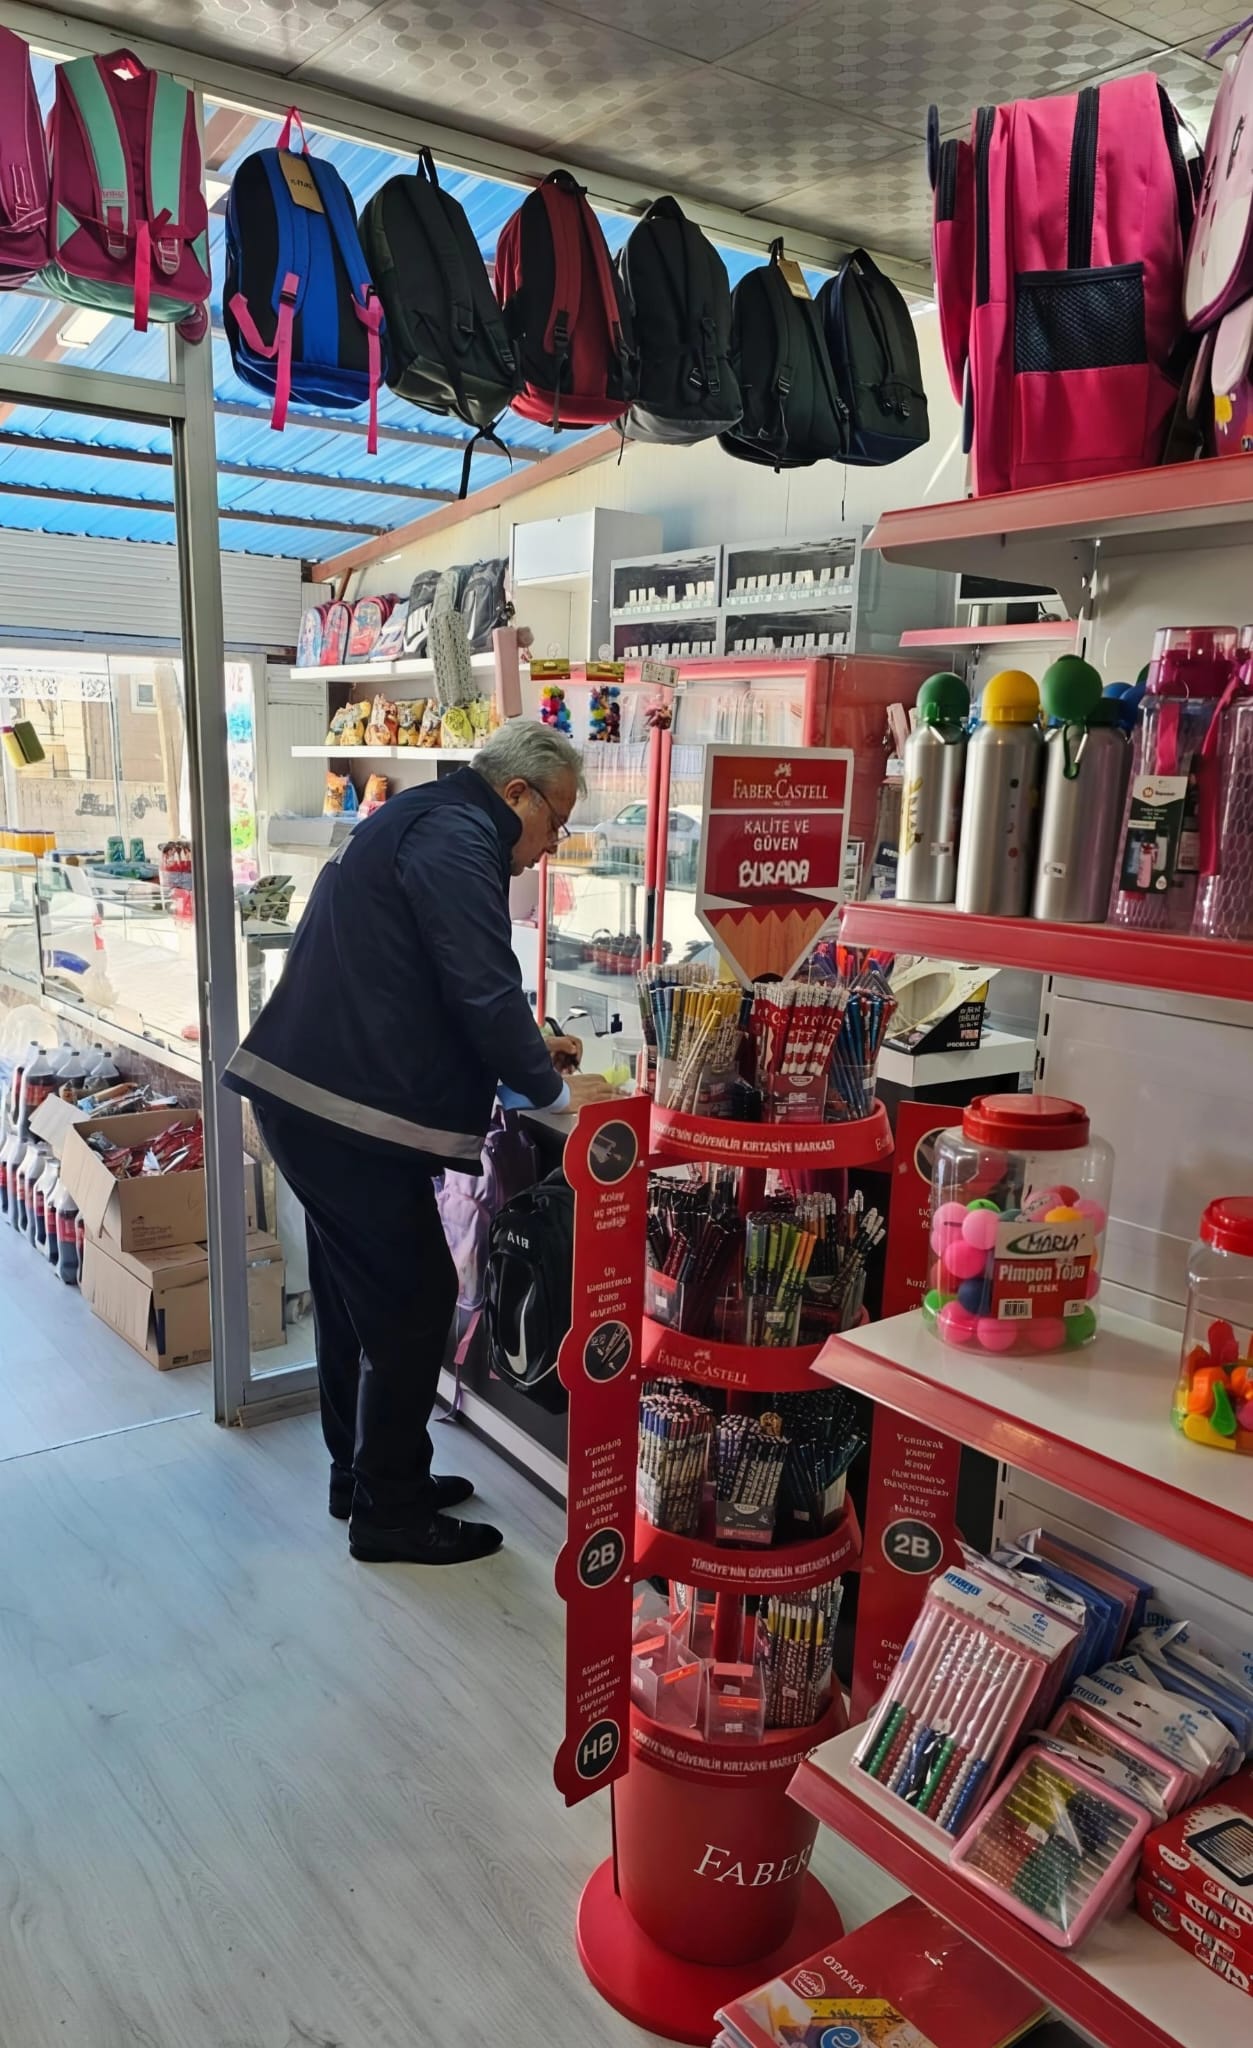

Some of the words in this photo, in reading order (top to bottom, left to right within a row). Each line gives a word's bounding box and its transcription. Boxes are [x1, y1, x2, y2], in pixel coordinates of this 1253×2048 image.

[733, 779, 829, 799] FABER-CASTELL
[744, 817, 790, 834] KALİTE
[794, 819, 810, 833] VE
[753, 835, 799, 851] GÜVEN
[738, 859, 811, 888] BURADA
[657, 1348, 750, 1385] FABER-CASTELL
[586, 1542, 617, 1574] 2B
[893, 1532, 931, 1560] 2B
[583, 1731, 613, 1766] HB
